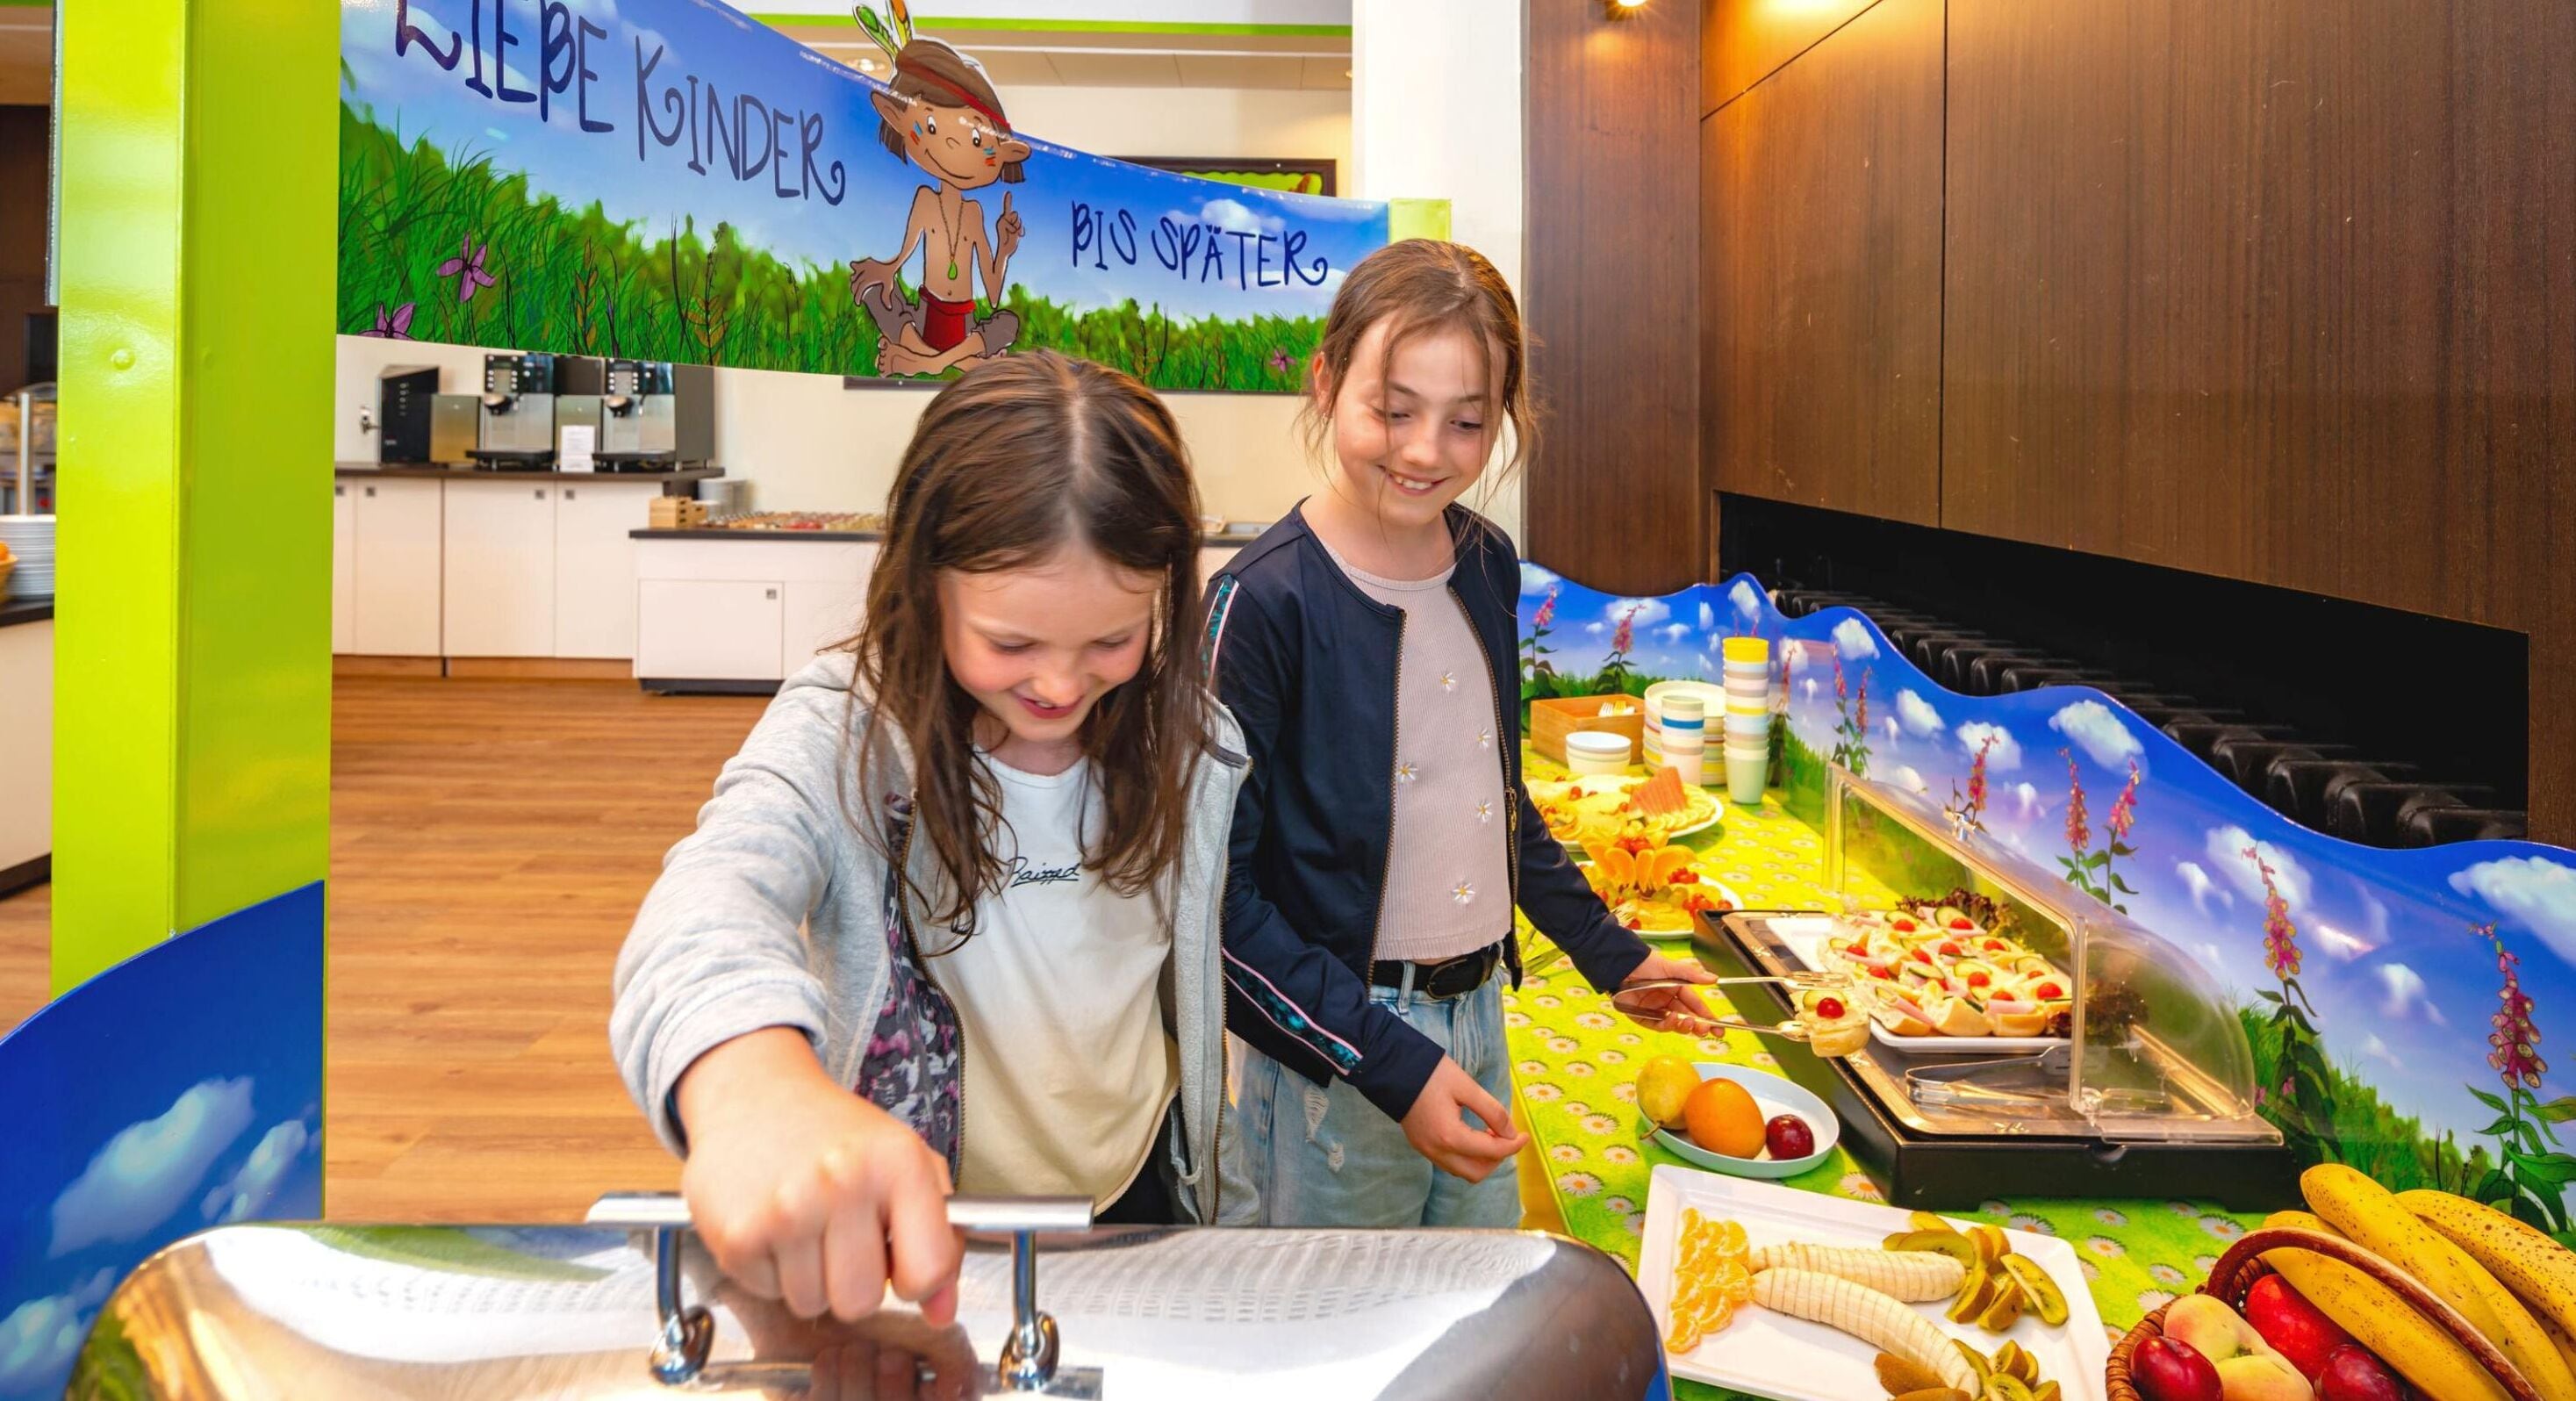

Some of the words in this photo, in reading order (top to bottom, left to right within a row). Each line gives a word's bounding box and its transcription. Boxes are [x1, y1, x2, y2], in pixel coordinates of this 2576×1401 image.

[635, 35, 845, 206] KINDER
[1071, 200, 1137, 271] BIS
[1152, 217, 1329, 291] SPÄTER
